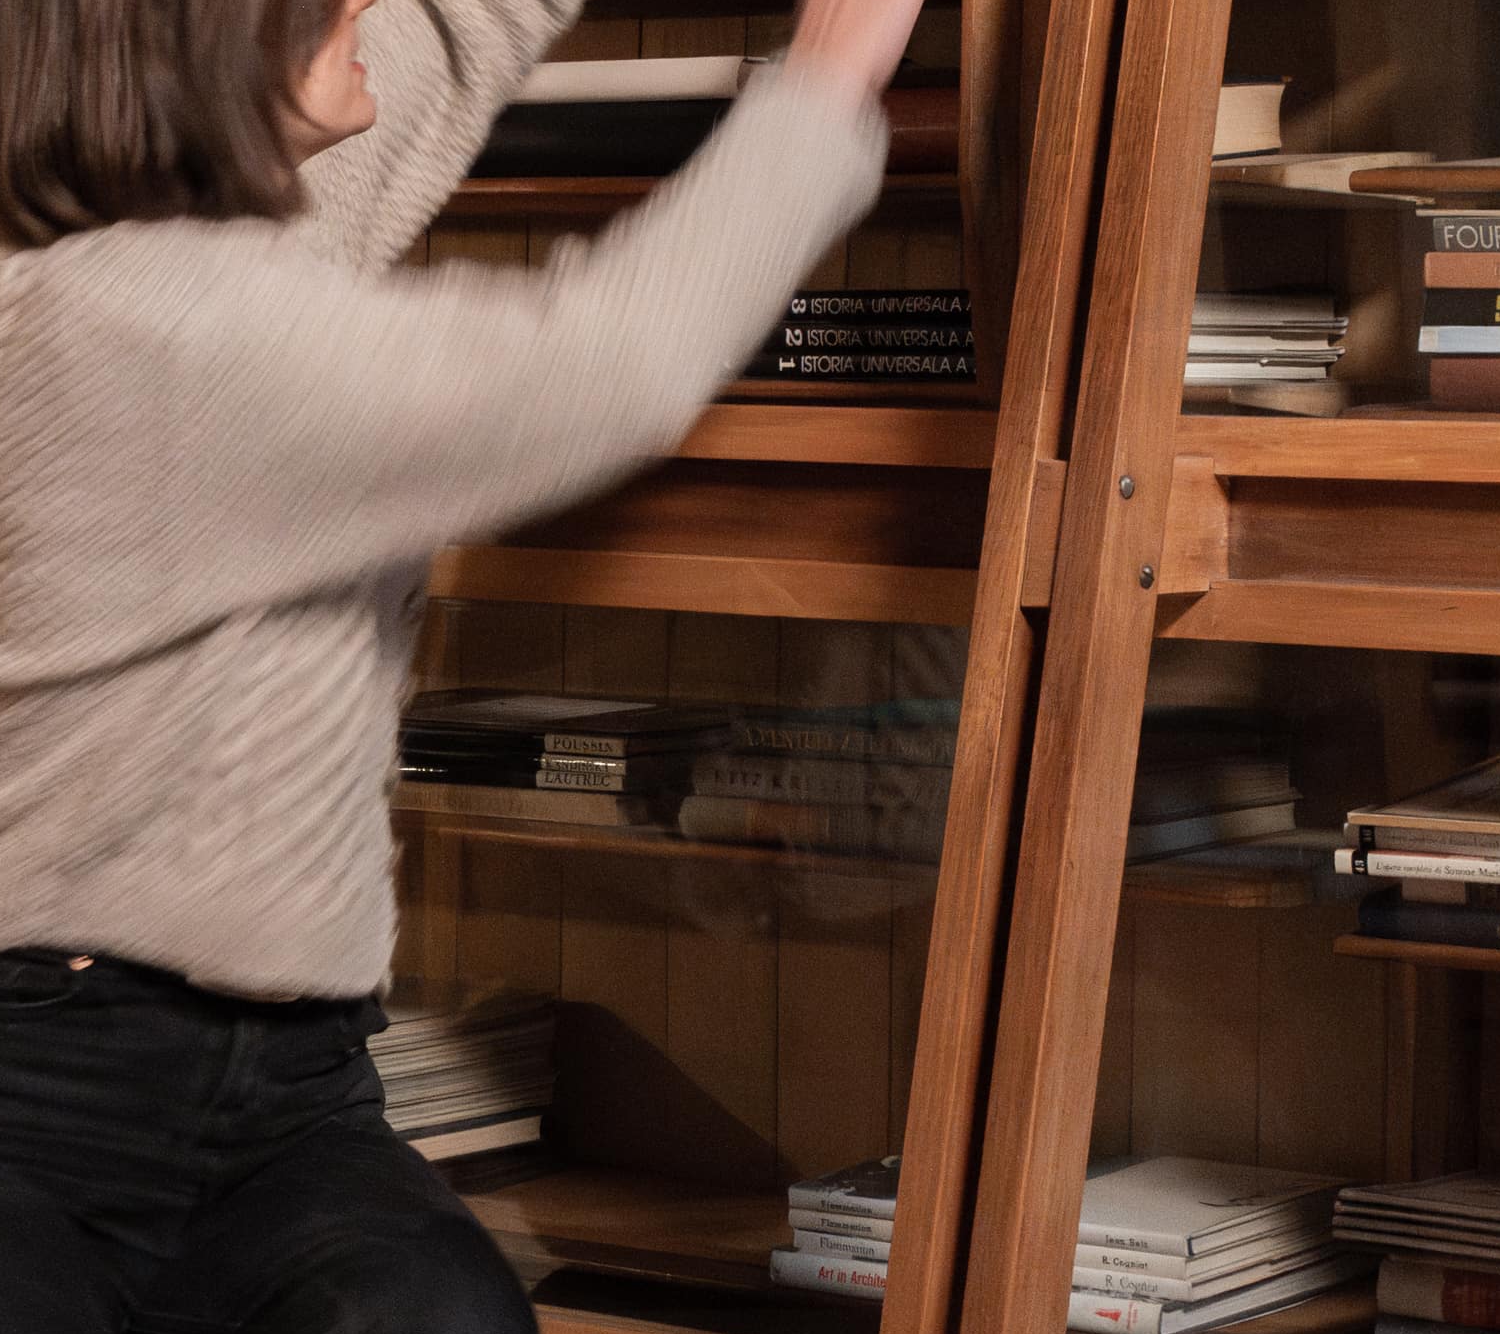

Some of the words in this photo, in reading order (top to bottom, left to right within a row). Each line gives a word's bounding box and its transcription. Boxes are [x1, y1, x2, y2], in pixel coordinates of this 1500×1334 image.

[790, 298, 807, 315] 3
[811, 297, 865, 314] ISTORIA
[871, 296, 962, 314] UNIVERSALA
[785, 327, 803, 347] 2
[807, 328, 864, 347] ISTORIA
[868, 328, 959, 347] UNIVERSALA
[778, 356, 797, 372] 1
[800, 355, 853, 373] ISTORIA
[860, 356, 952, 374] UNIVERSALA
[552, 737, 614, 754] POUSSIN
[543, 771, 611, 788] LAUTREC
[1444, 865, 1476, 877] Simone
[818, 1266, 834, 1281] Art
[836, 1271, 847, 1284] in
